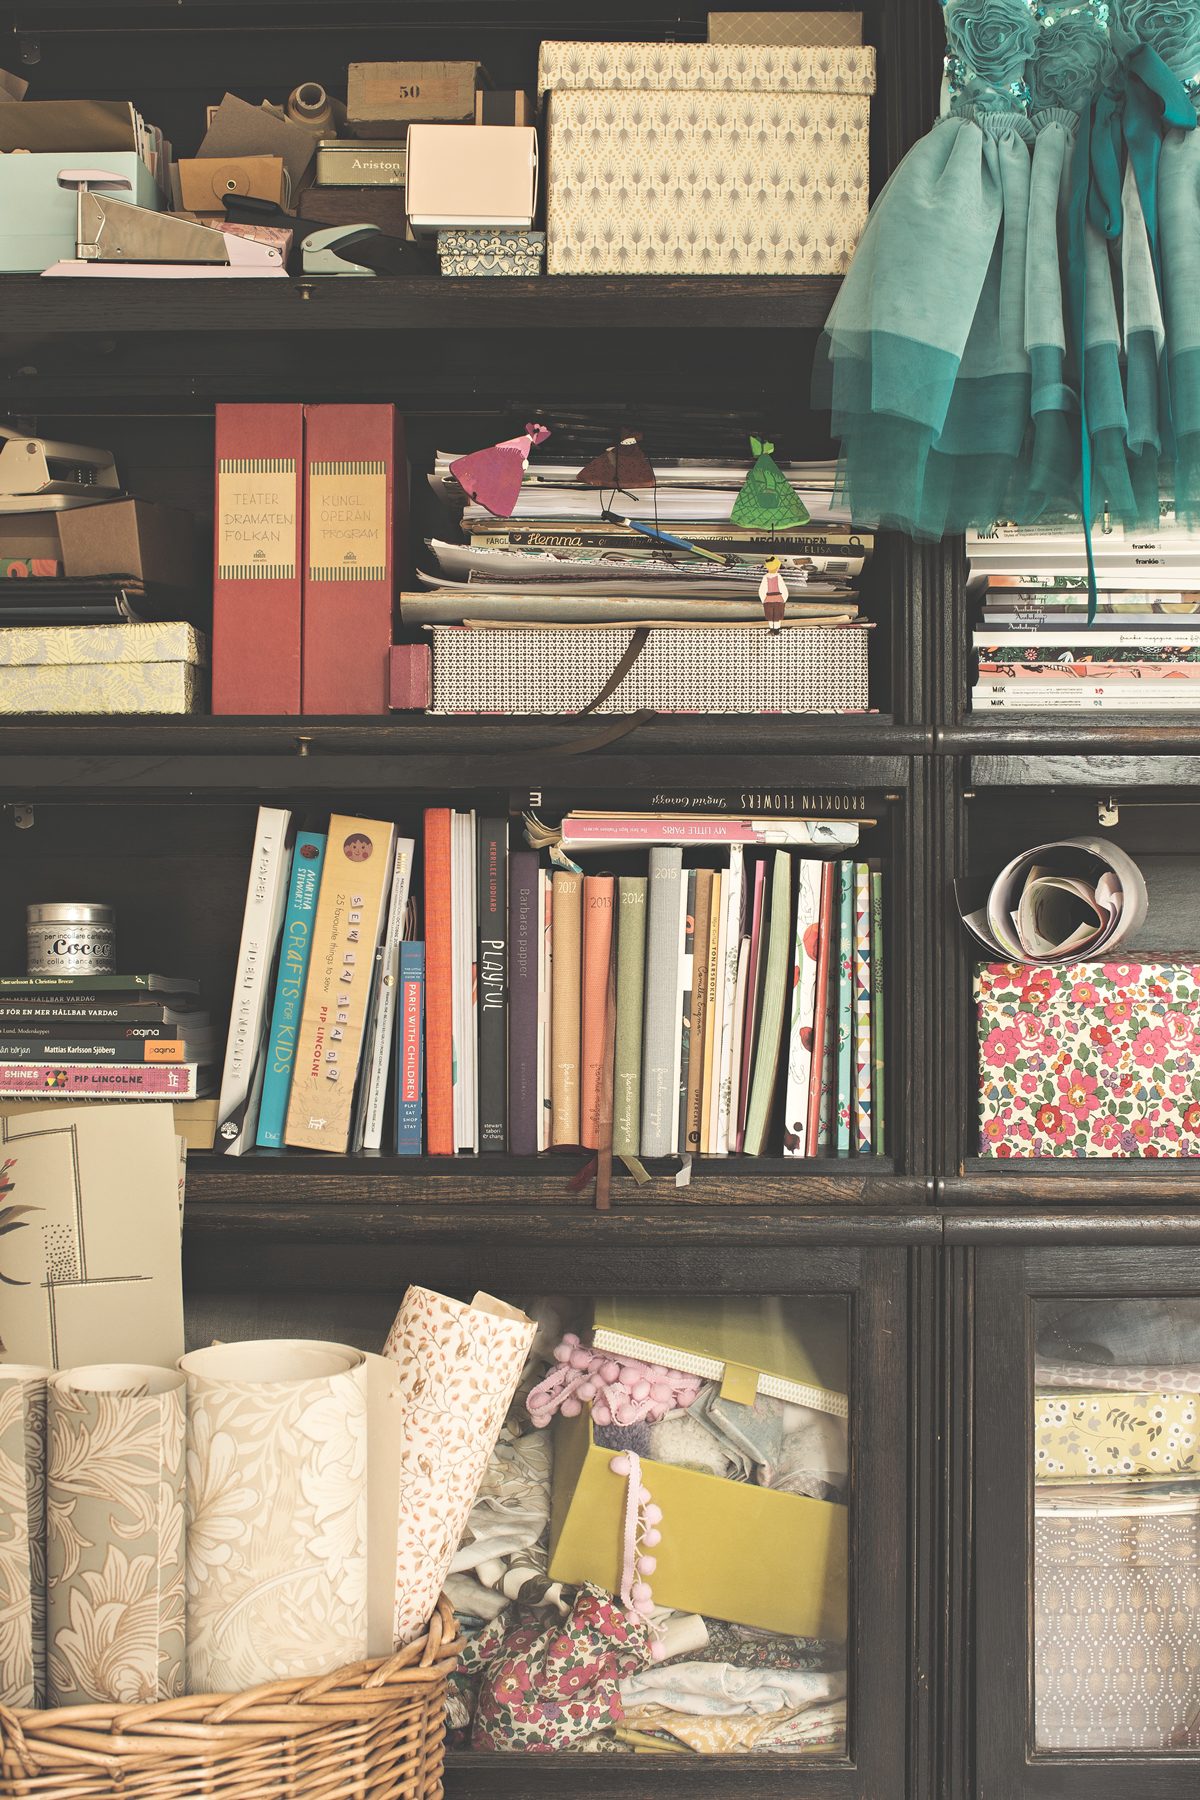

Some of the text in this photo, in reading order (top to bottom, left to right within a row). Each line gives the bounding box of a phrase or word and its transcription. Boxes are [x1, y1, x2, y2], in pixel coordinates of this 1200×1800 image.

[400, 86, 420, 98] 50
[352, 160, 400, 170] Ariston
[233, 494, 278, 505] TEATER
[224, 513, 294, 525] DRAMATEN
[320, 510, 371, 522] OPERAN
[225, 530, 280, 542] FOLKAN
[320, 529, 378, 540] PROGRAM
[527, 533, 583, 546] Hemma
[1008, 623, 1039, 632] Anthology
[692, 797, 727, 808] Ingrid
[741, 794, 864, 810] BROOKLYN FLOWERS
[662, 826, 727, 834] MY LITTLE PARIS
[655, 868, 677, 879] 2015
[294, 868, 307, 910] STEWART'S
[303, 869, 316, 910] MARTHA
[558, 882, 576, 893] 2012
[336, 894, 345, 905] 25
[590, 897, 611, 908] 2013
[622, 893, 644, 904] 2014
[331, 906, 344, 940] favourite
[517, 888, 530, 977] Barbaras papper
[326, 942, 336, 964] things
[326, 966, 334, 975] to
[283, 1002, 294, 1020] FOR
[126, 1029, 160, 1037] pagina
[311, 1006, 328, 1077] PIP LINCOLNE
[10, 1046, 31, 1056] början
[93, 1046, 116, 1055] Sjöberg
[274, 1024, 296, 1074] KIDS
[407, 1046, 416, 1098] CHILDREN
[620, 1073, 637, 1143] frankie magazine
